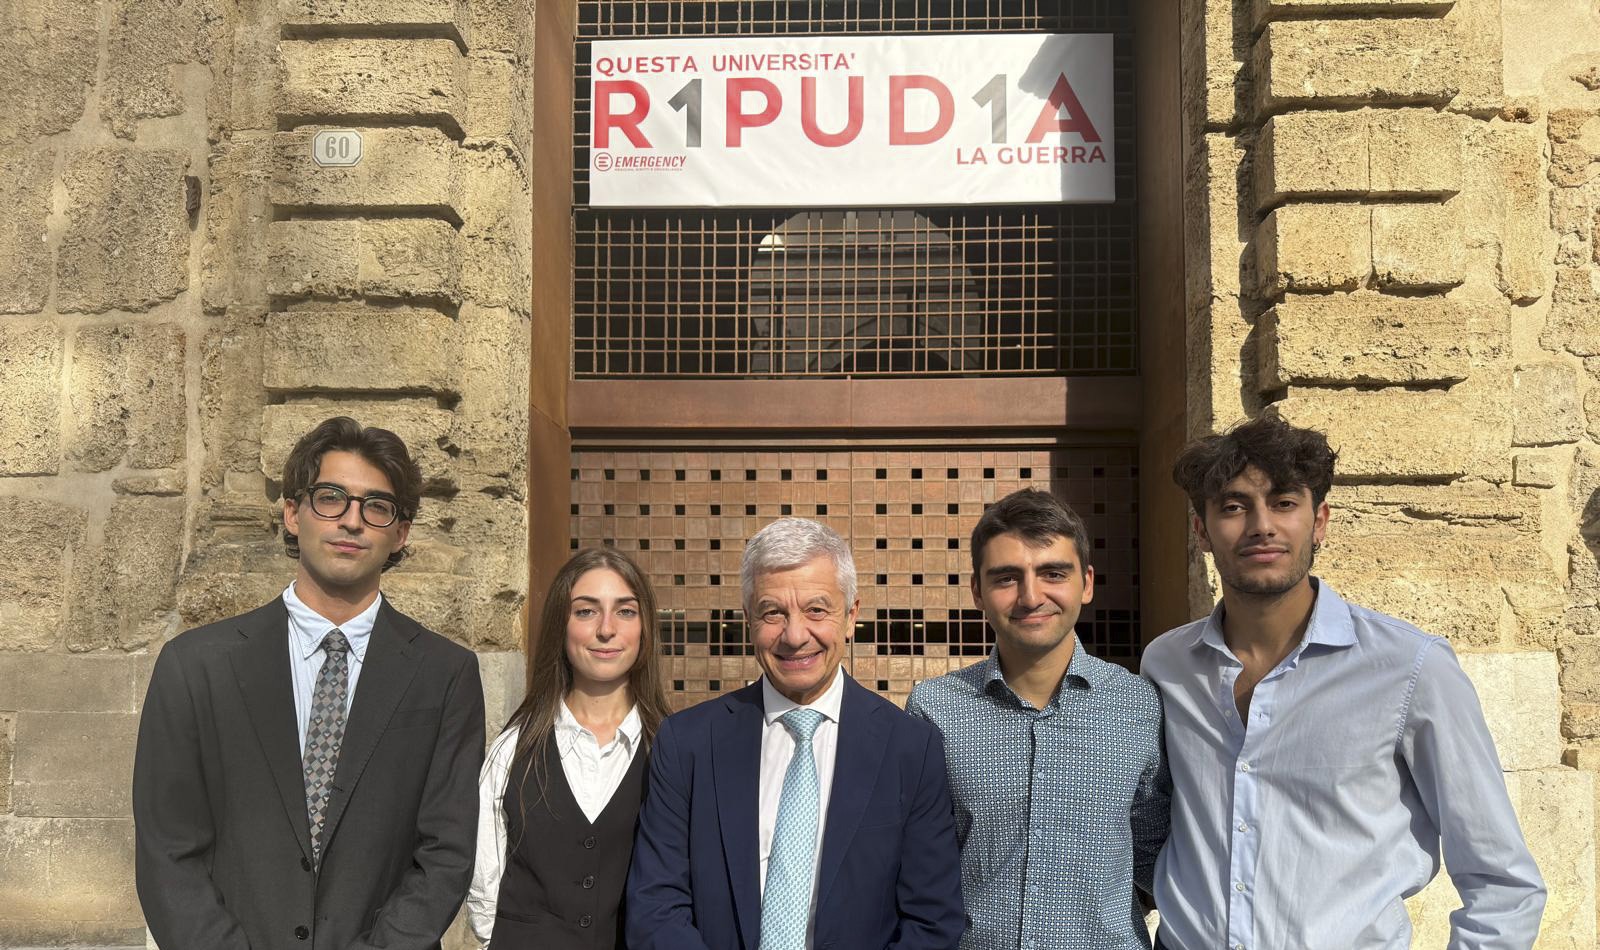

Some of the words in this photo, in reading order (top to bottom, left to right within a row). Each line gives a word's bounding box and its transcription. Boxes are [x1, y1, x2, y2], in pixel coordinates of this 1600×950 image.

[596, 55, 698, 76] QUESTA
[712, 52, 855, 72] UNIVERSITA'
[594, 72, 1103, 149] R1PUD1A
[326, 136, 349, 159] 60
[956, 148, 988, 165] LA
[997, 146, 1106, 165] GUERRA
[615, 156, 687, 168] EMERGENCY
